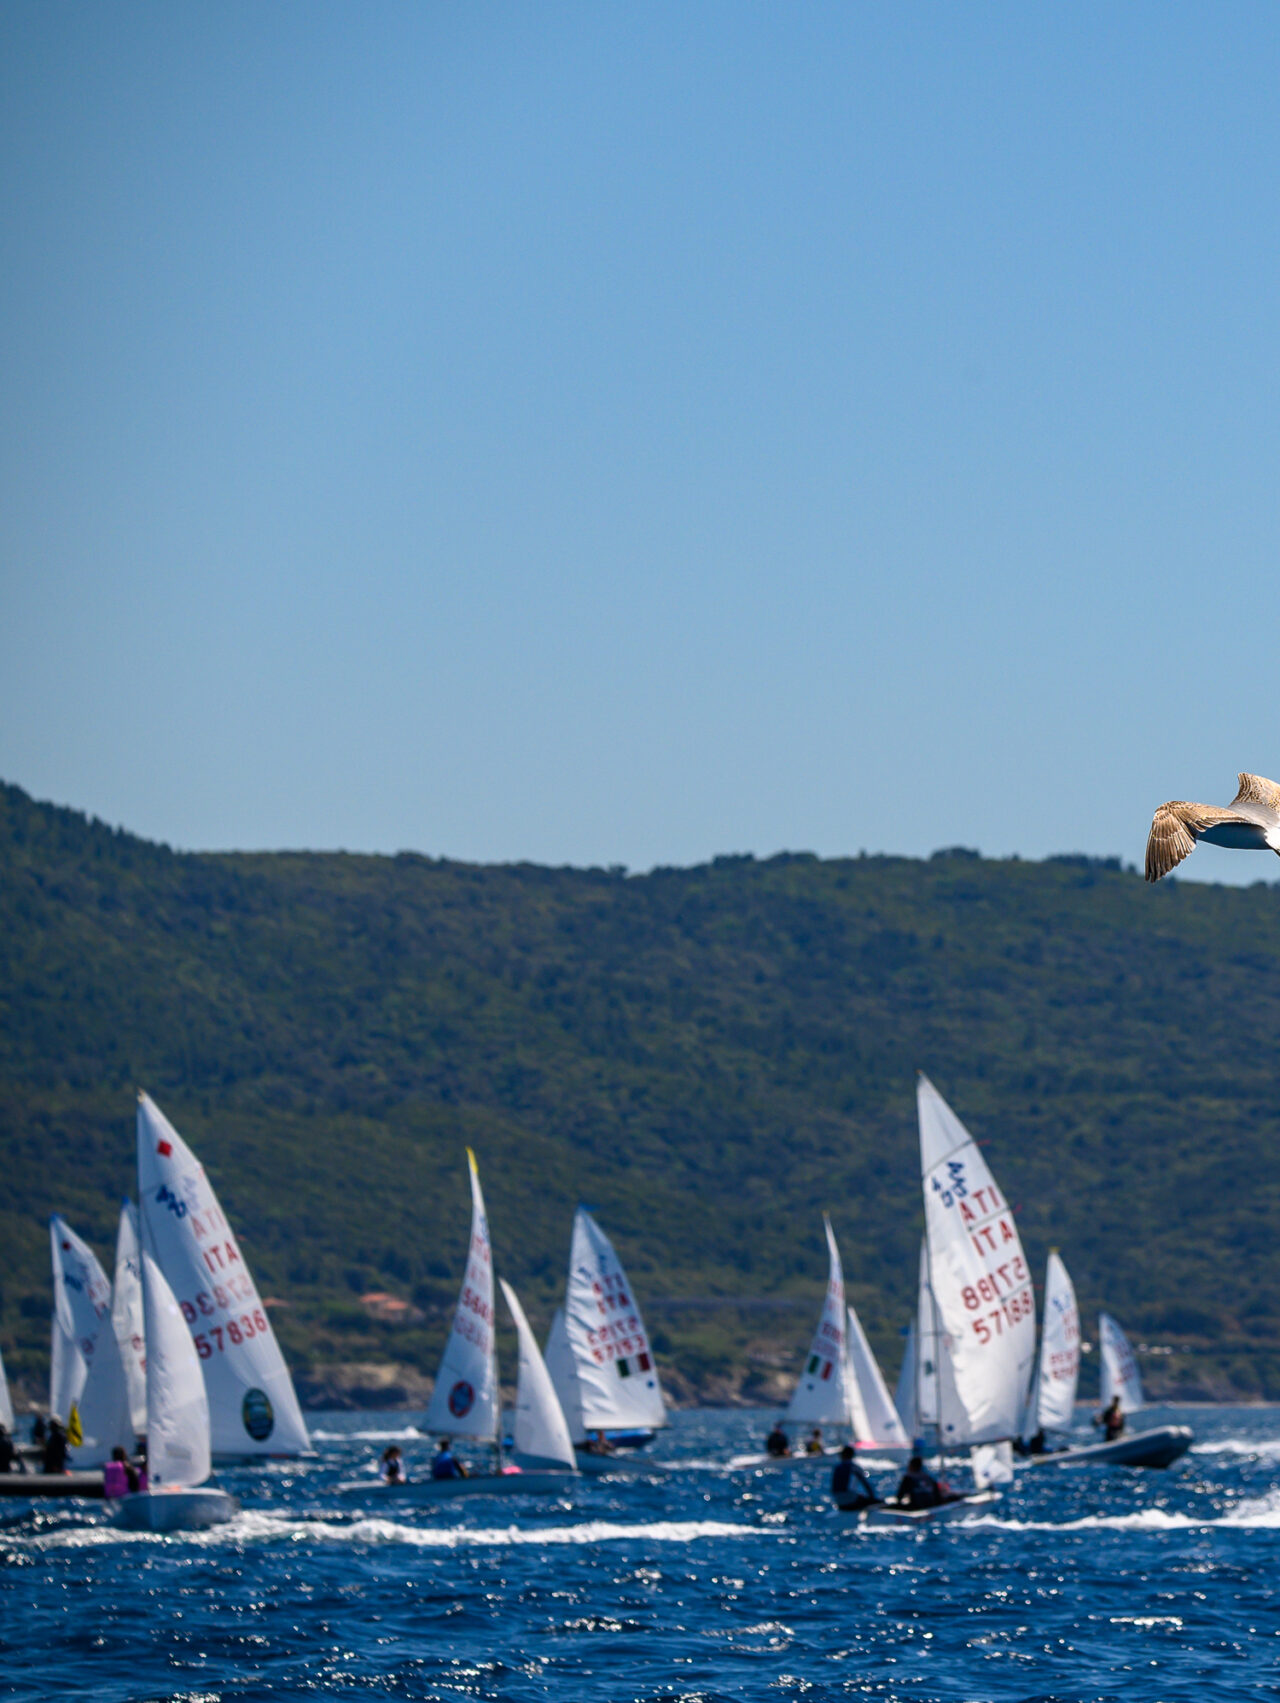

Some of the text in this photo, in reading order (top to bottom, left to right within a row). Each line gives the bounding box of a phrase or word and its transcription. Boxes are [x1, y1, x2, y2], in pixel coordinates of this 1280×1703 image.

[202, 1240, 239, 1274] ITA
[971, 1219, 1014, 1258] ITA
[194, 1309, 268, 1361] 57836
[971, 1291, 1034, 1346] 57188
